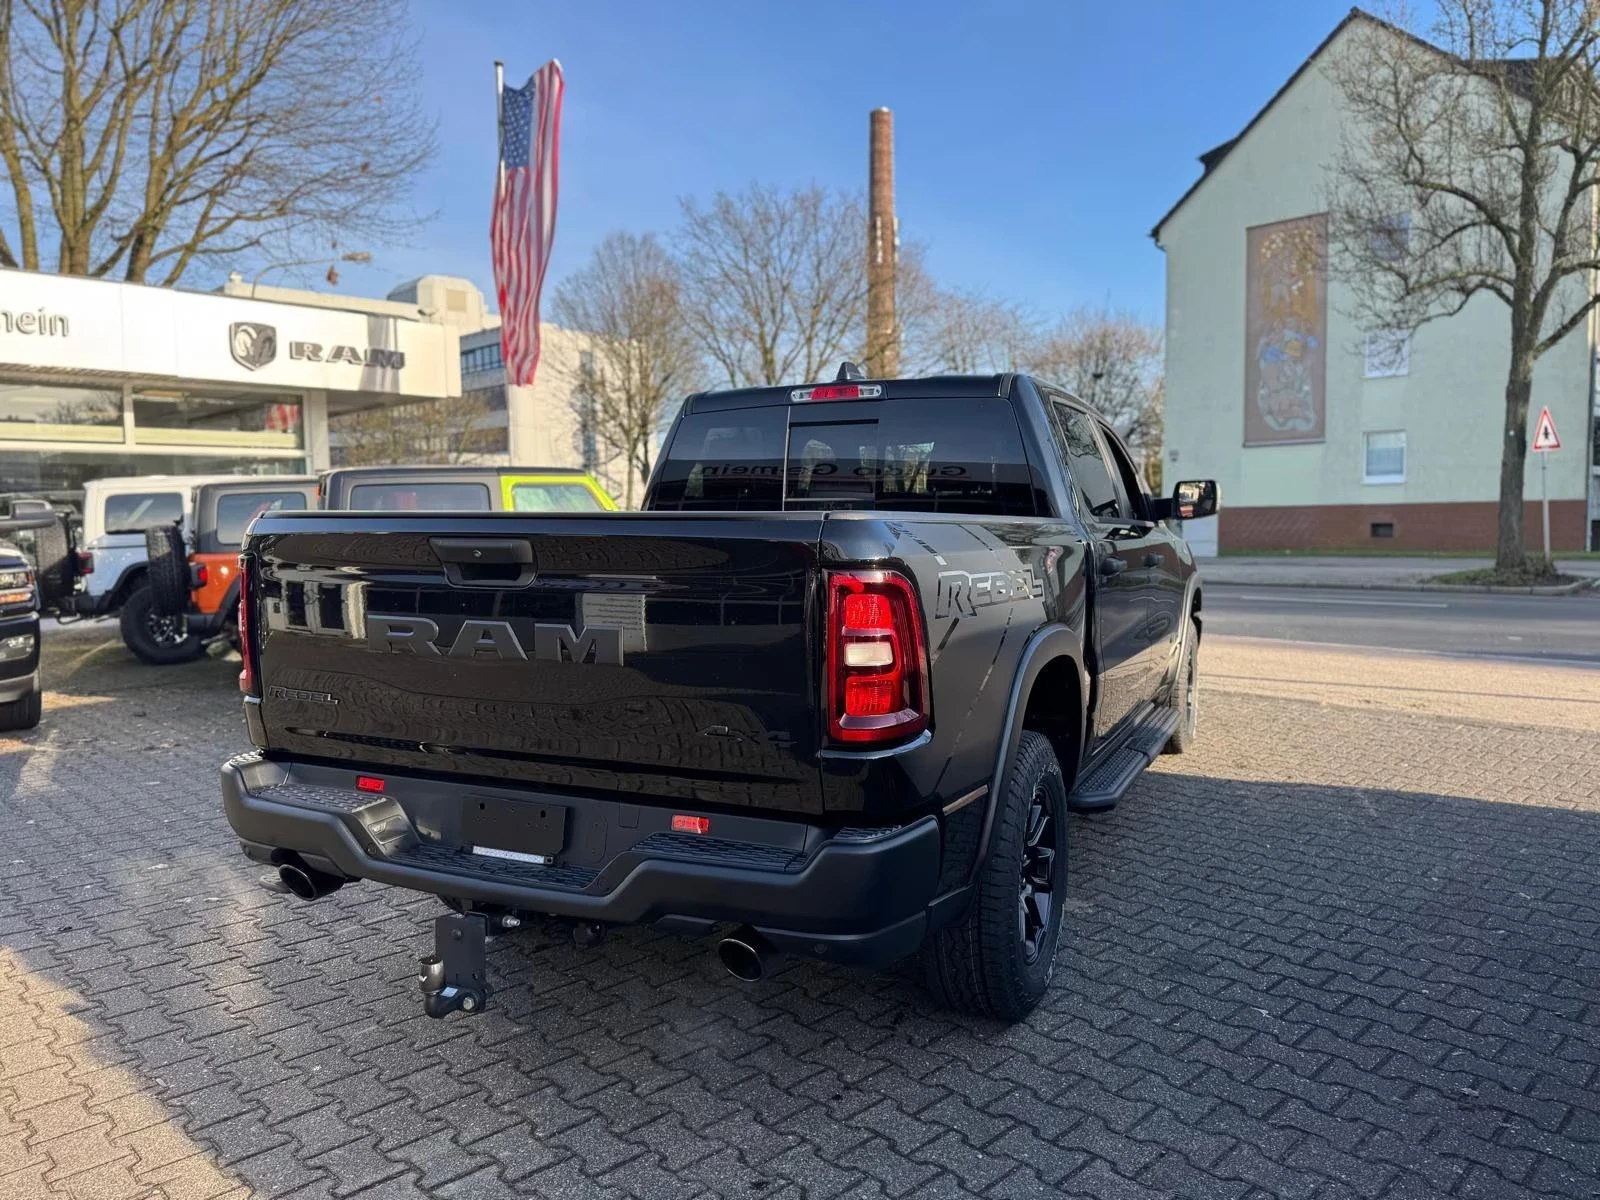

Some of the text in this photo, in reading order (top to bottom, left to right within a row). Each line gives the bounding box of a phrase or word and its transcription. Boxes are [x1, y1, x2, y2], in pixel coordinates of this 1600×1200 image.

[289, 341, 405, 370] RAM
[935, 564, 1045, 619] REBEL
[367, 614, 624, 667] RAM
[268, 685, 339, 704] REBEL
